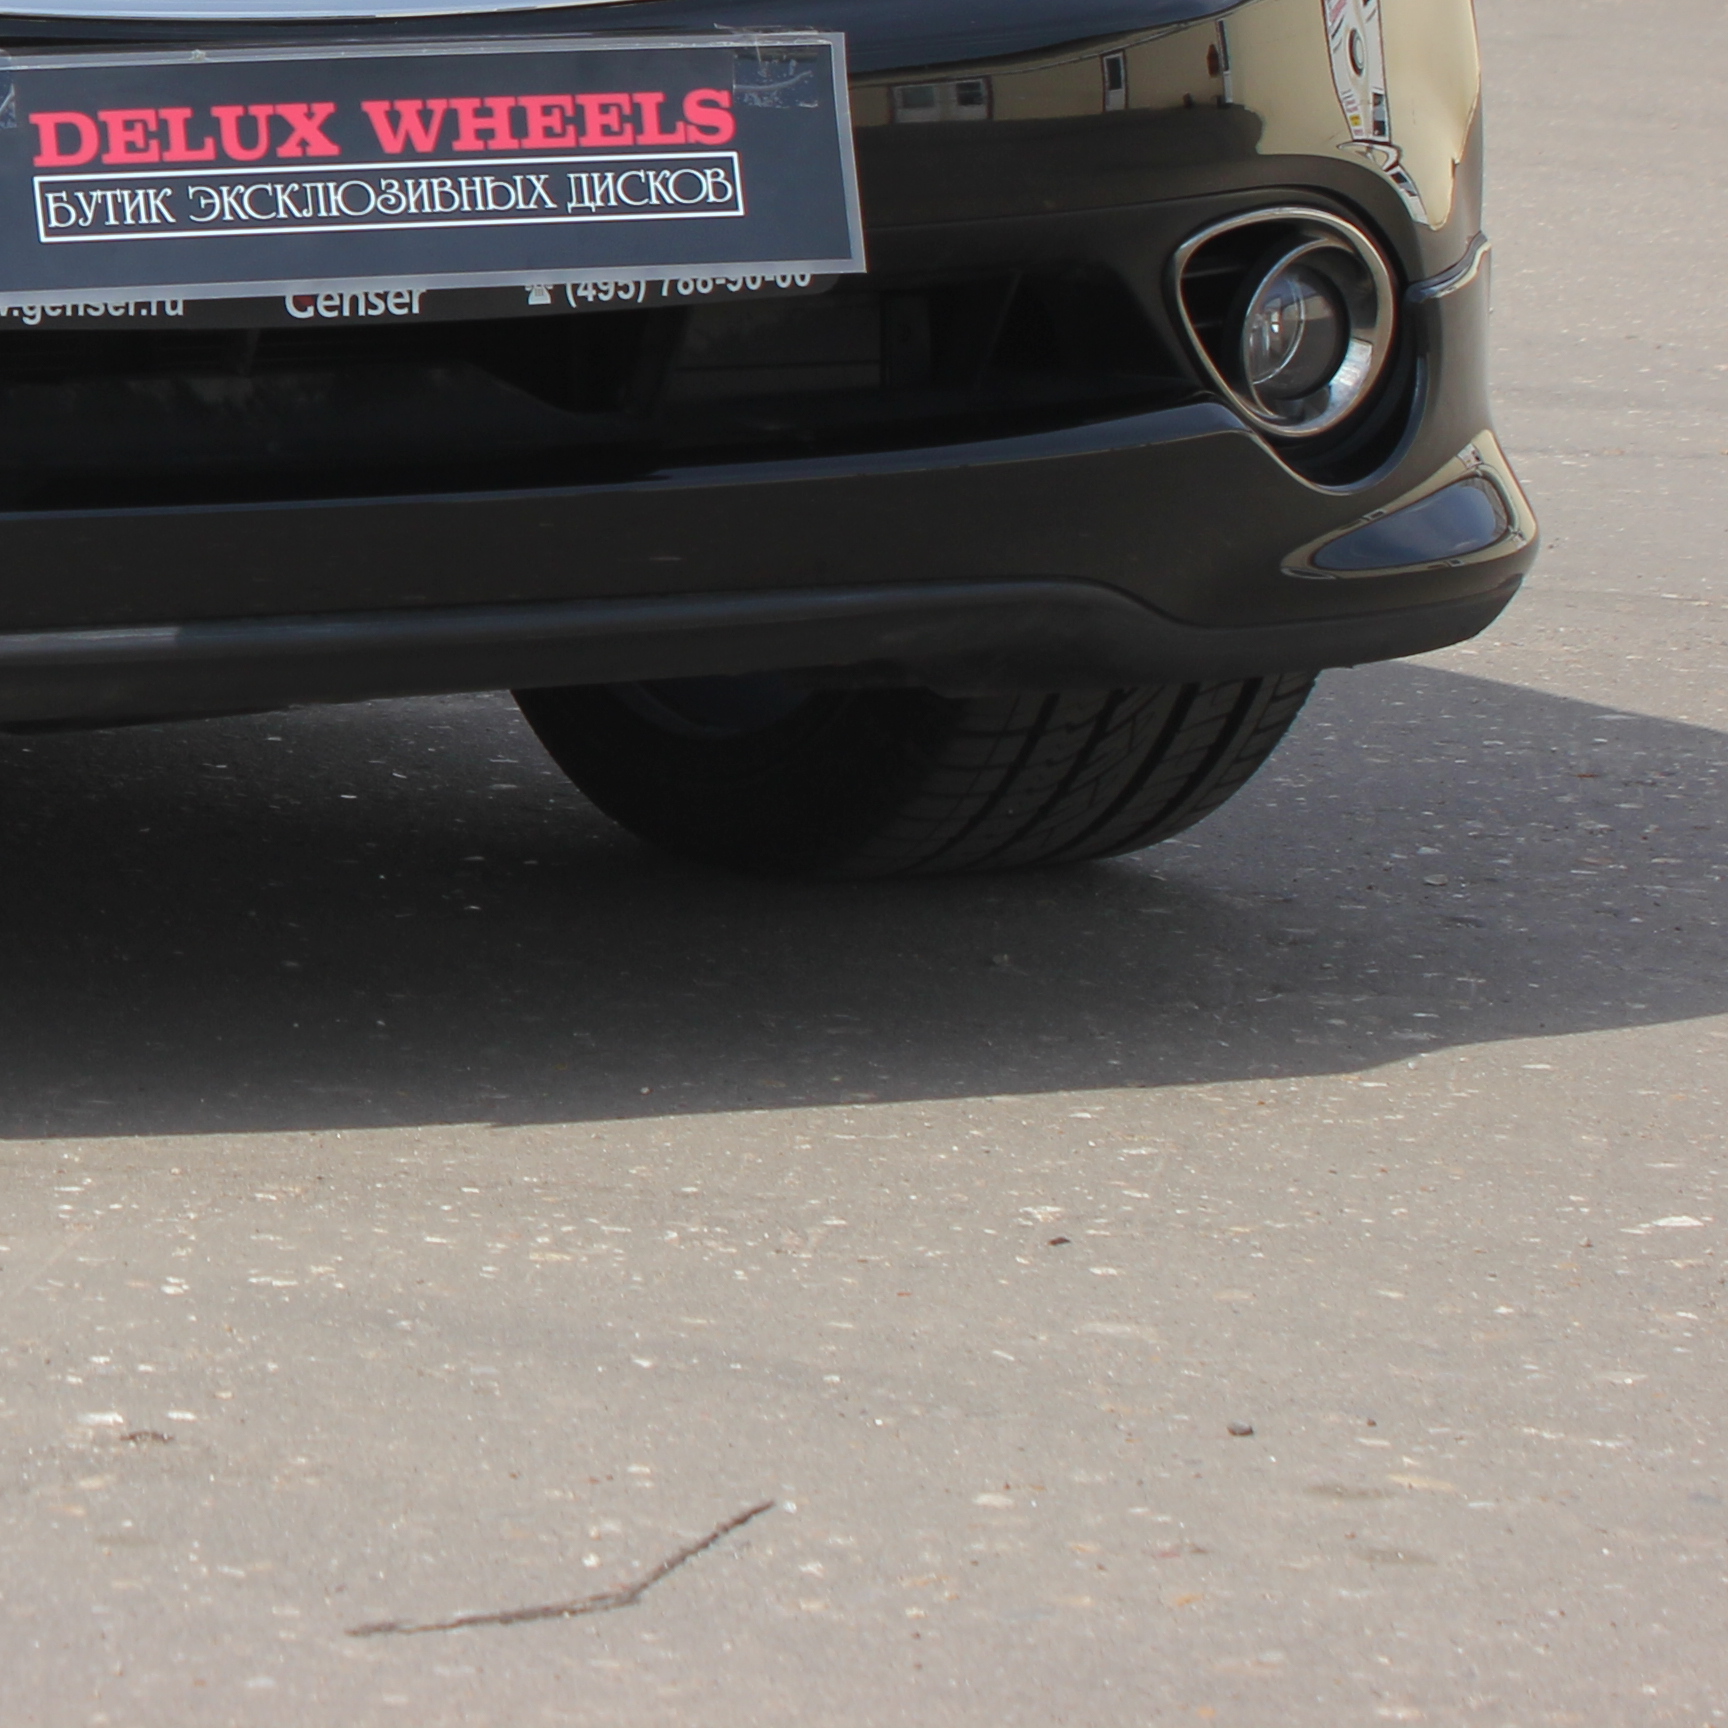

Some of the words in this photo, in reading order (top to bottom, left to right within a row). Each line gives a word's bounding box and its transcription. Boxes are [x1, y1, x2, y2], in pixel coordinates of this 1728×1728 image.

[28, 100, 342, 168] DELUX
[360, 87, 737, 155] WHEELS
[44, 186, 177, 229] БУТИК
[187, 173, 558, 223] ЭКСКЛЮЗИВНЫХ
[565, 167, 734, 215] ДИСКОВ
[284, 289, 426, 320] Genser
[565, 279, 646, 309] (495)
